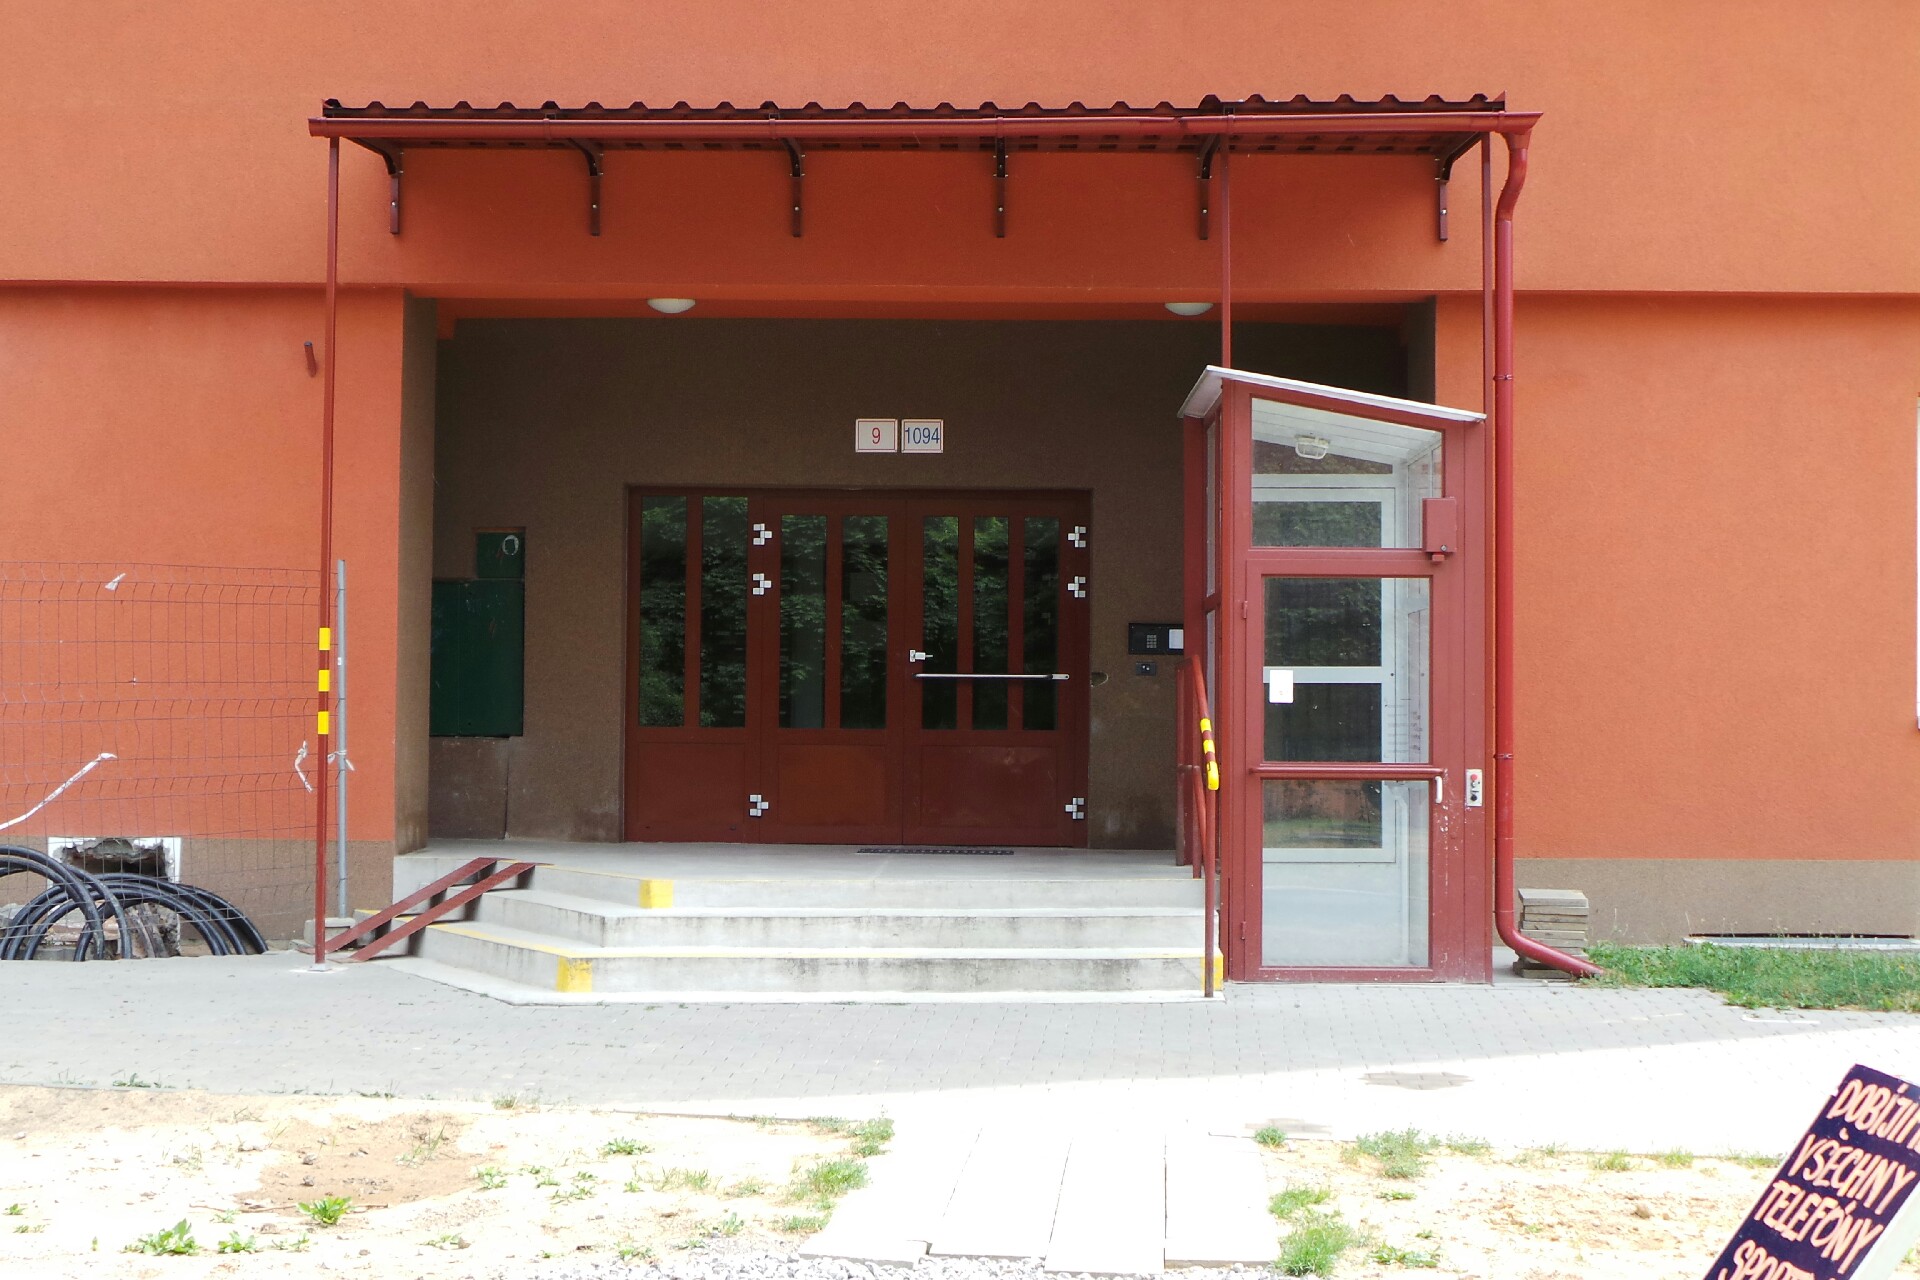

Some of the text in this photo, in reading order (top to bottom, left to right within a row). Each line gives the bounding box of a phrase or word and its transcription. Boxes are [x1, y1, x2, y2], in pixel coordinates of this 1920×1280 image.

[872, 427, 881, 444] 9
[904, 427, 940, 444] 1094
[1788, 1127, 1917, 1215] VŠECHNY
[1754, 1180, 1884, 1274] TELEFÓNY
